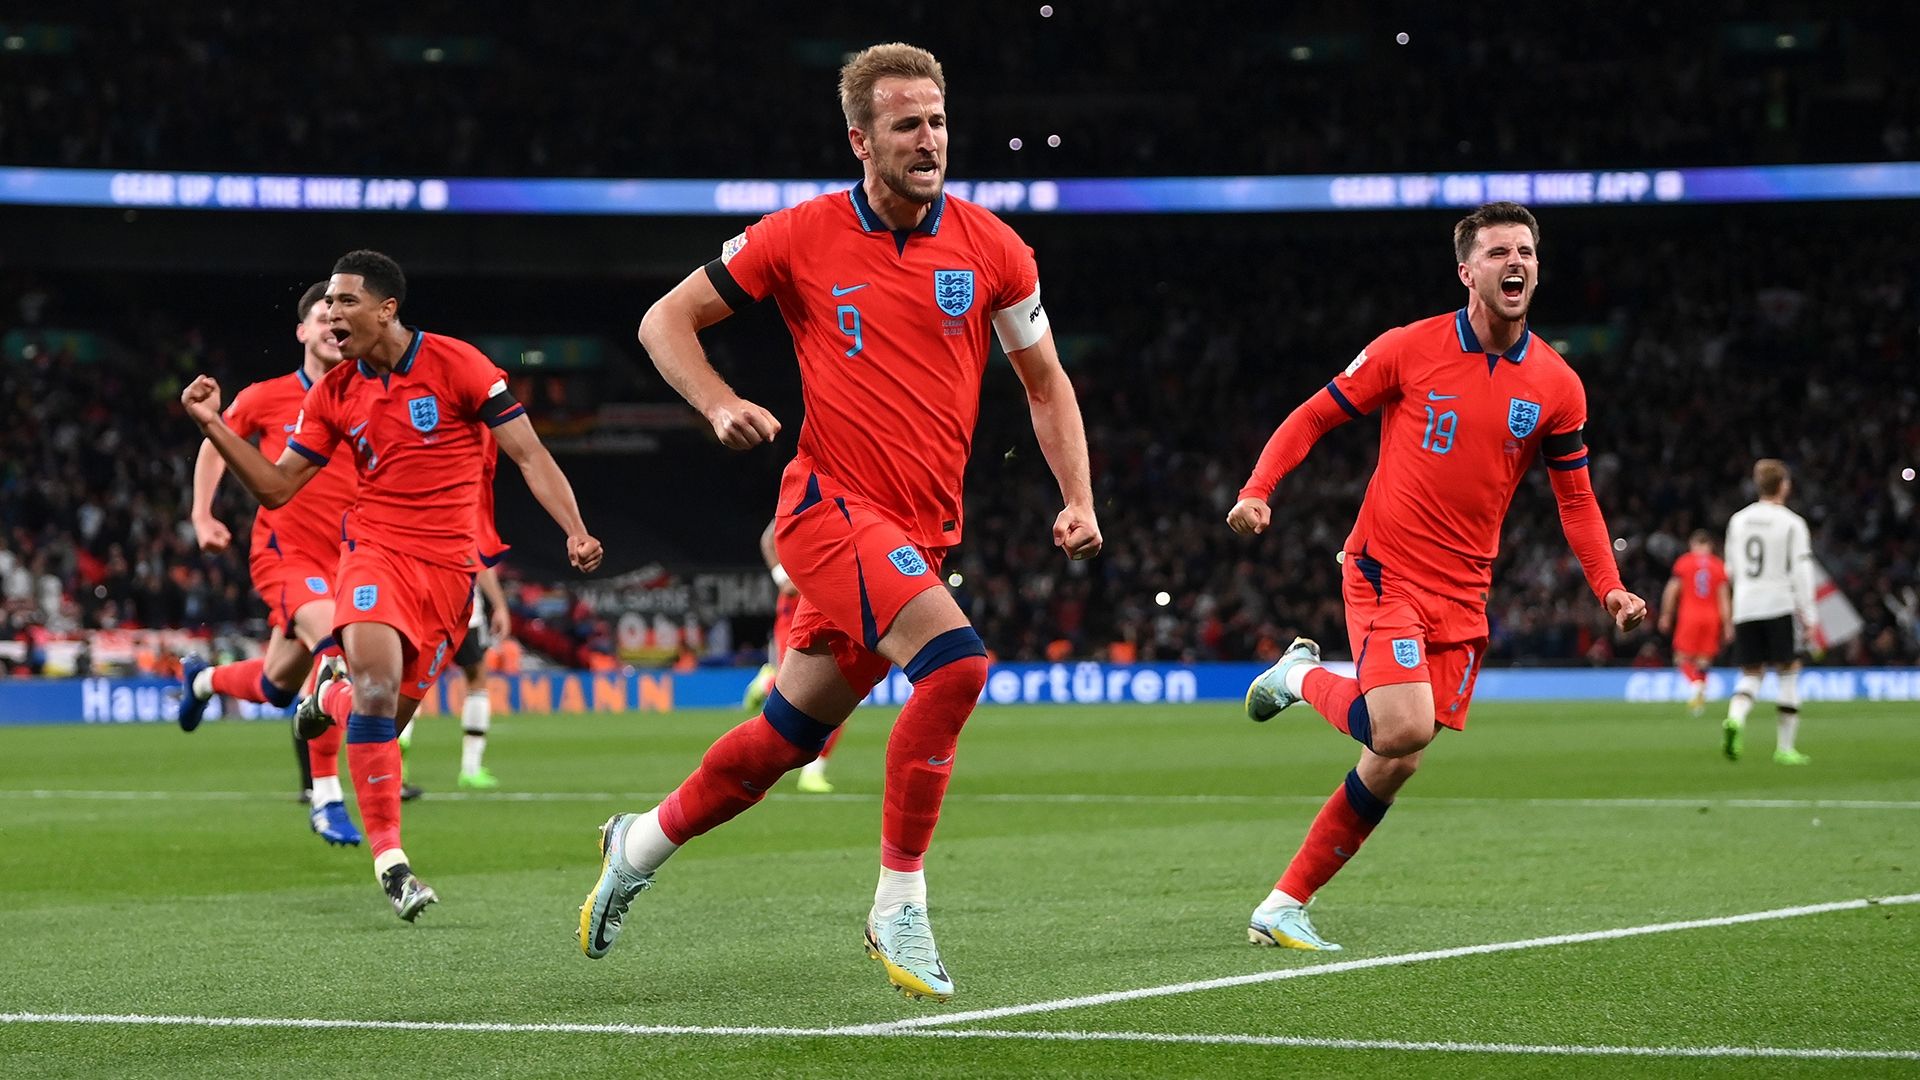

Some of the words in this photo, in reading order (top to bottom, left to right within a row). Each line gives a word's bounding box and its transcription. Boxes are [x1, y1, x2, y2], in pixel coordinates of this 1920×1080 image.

[111, 172, 176, 206] GEAR
[177, 174, 213, 206] UP
[216, 175, 255, 207] ON
[256, 176, 300, 208] THE
[303, 177, 363, 209] NIKE
[364, 178, 415, 210] APP
[713, 182, 781, 211] GEAR
[1329, 176, 1397, 207] GEAR
[1400, 175, 1440, 206] UP
[1443, 174, 1483, 206] ON
[1486, 174, 1530, 203] THE
[1533, 173, 1595, 203] NIKE
[1596, 172, 1650, 202] APP
[836, 304, 863, 358] 9
[1421, 405, 1458, 454] 19
[1745, 535, 1764, 578] 9
